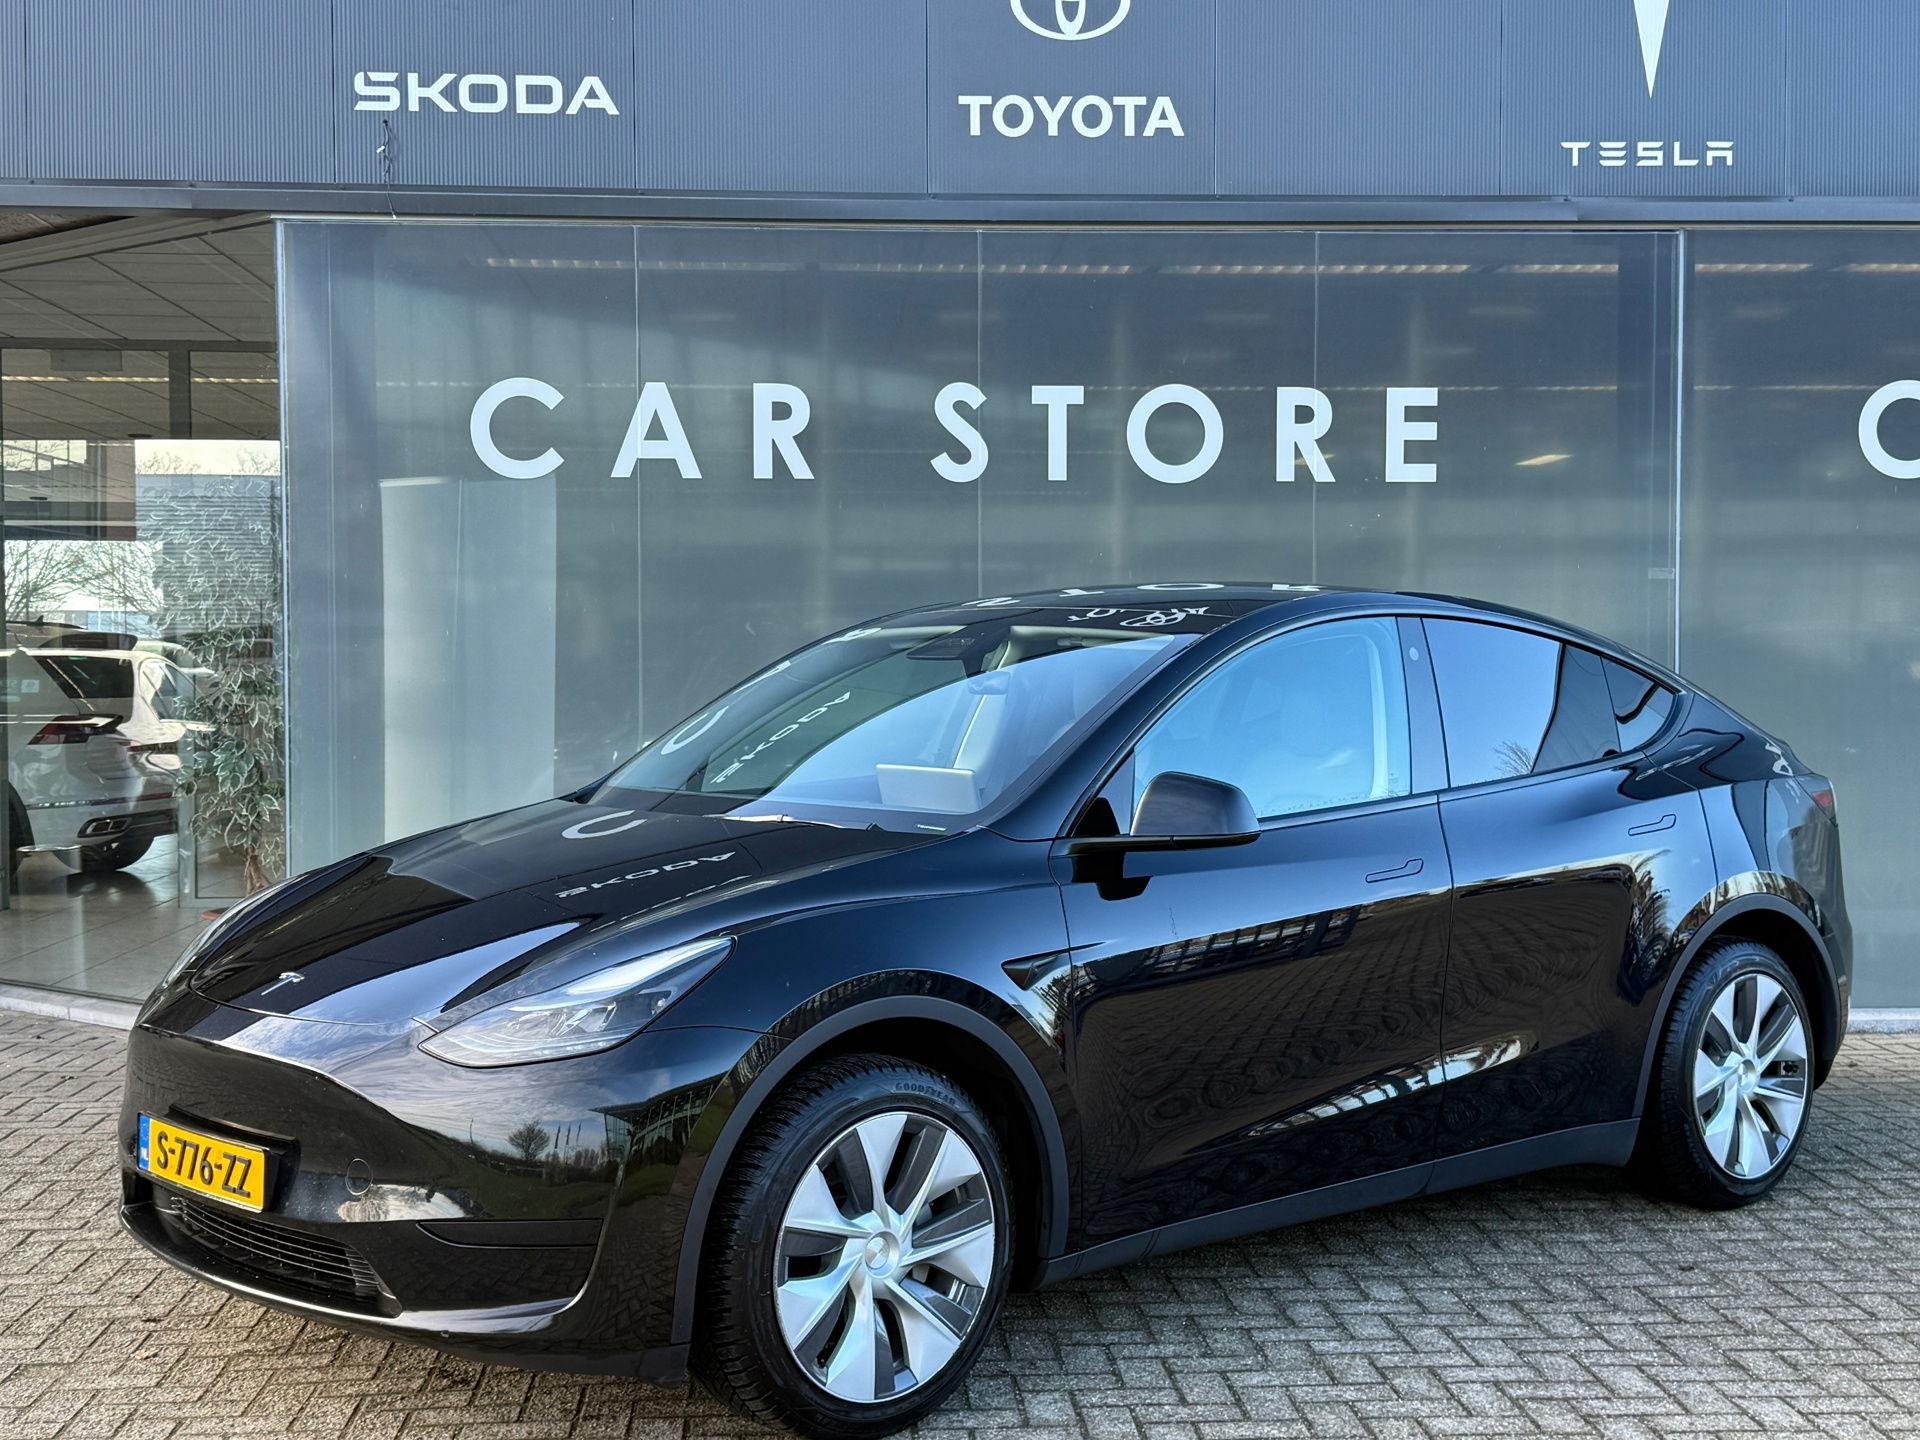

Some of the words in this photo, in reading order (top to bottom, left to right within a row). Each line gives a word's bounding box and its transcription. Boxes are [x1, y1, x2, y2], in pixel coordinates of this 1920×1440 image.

[958, 94, 1185, 138] TOYOTA
[1560, 141, 1734, 167] TESLA
[470, 377, 815, 480] CAR
[930, 382, 1438, 484] STORE
[157, 1130, 252, 1199] S-776-ZZ
